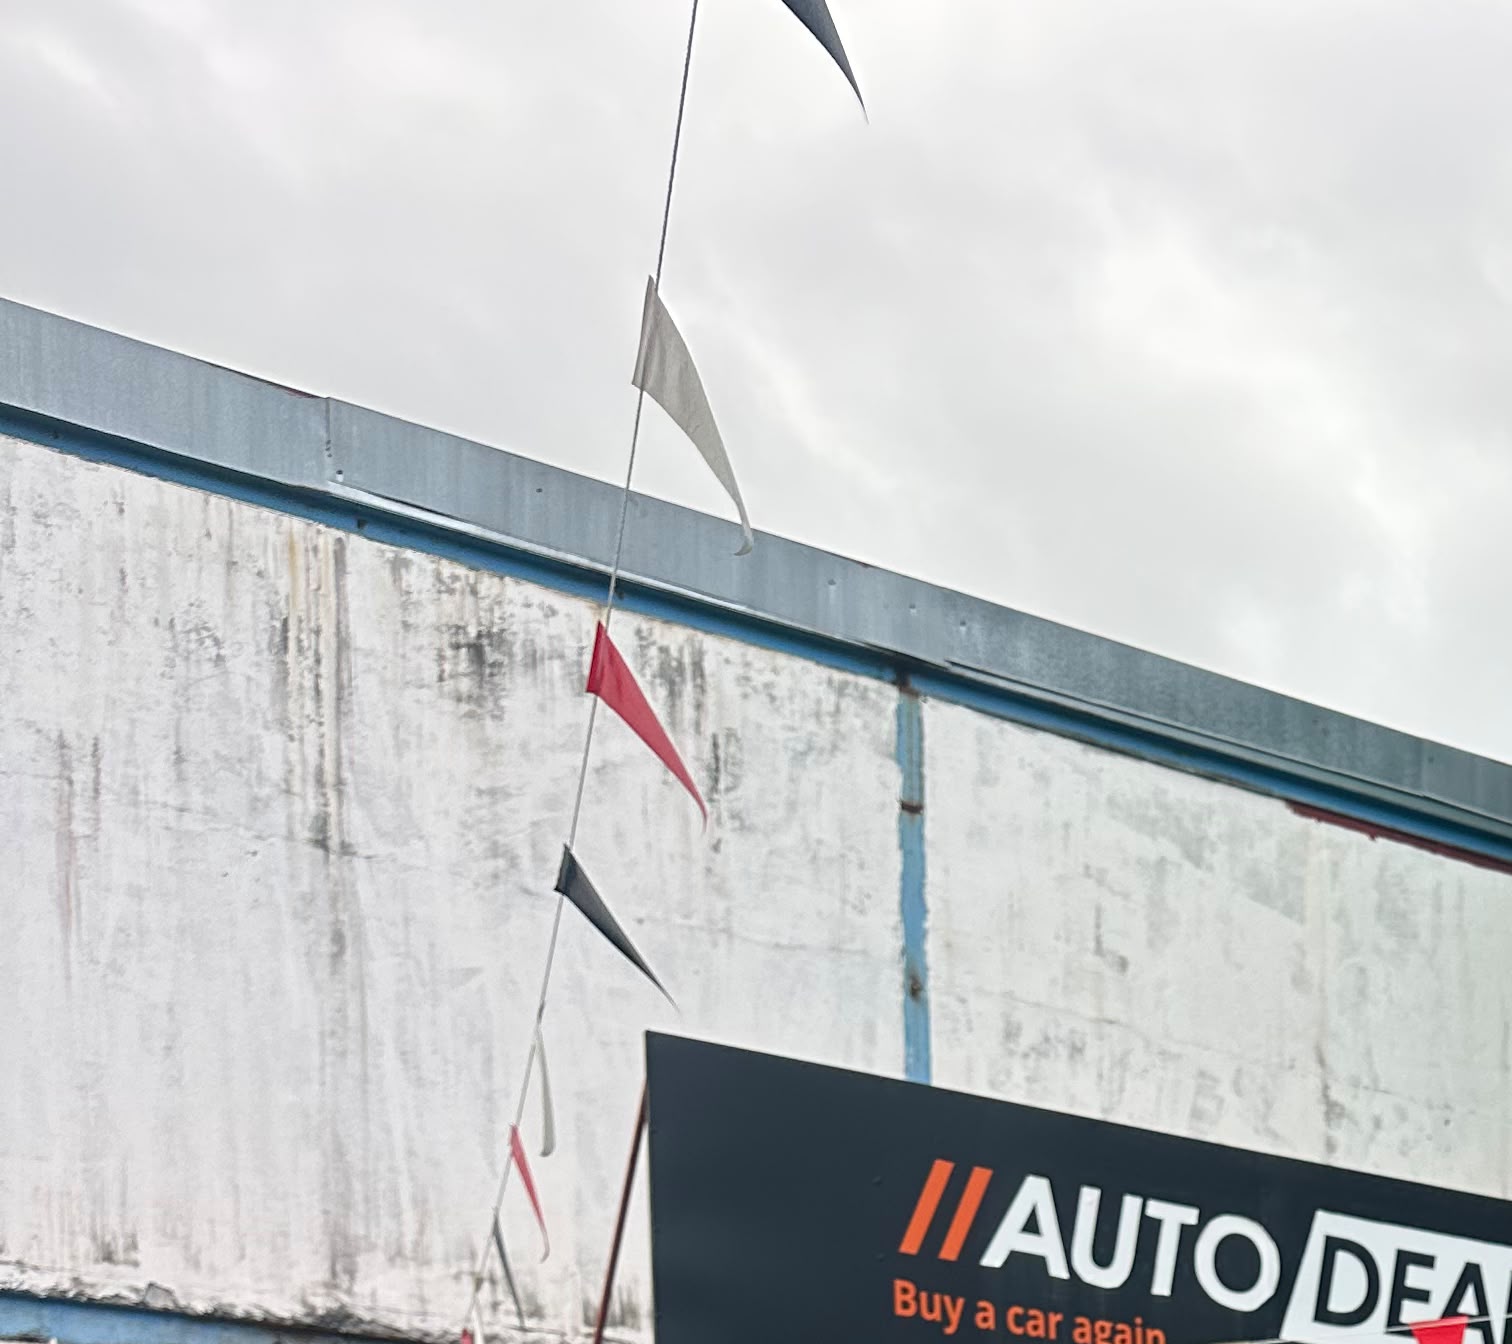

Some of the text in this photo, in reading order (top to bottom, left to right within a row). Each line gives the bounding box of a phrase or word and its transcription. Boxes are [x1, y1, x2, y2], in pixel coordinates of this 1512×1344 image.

[892, 1278, 965, 1335] Buy
[973, 1299, 997, 1331] a
[1005, 1303, 1064, 1340] car
